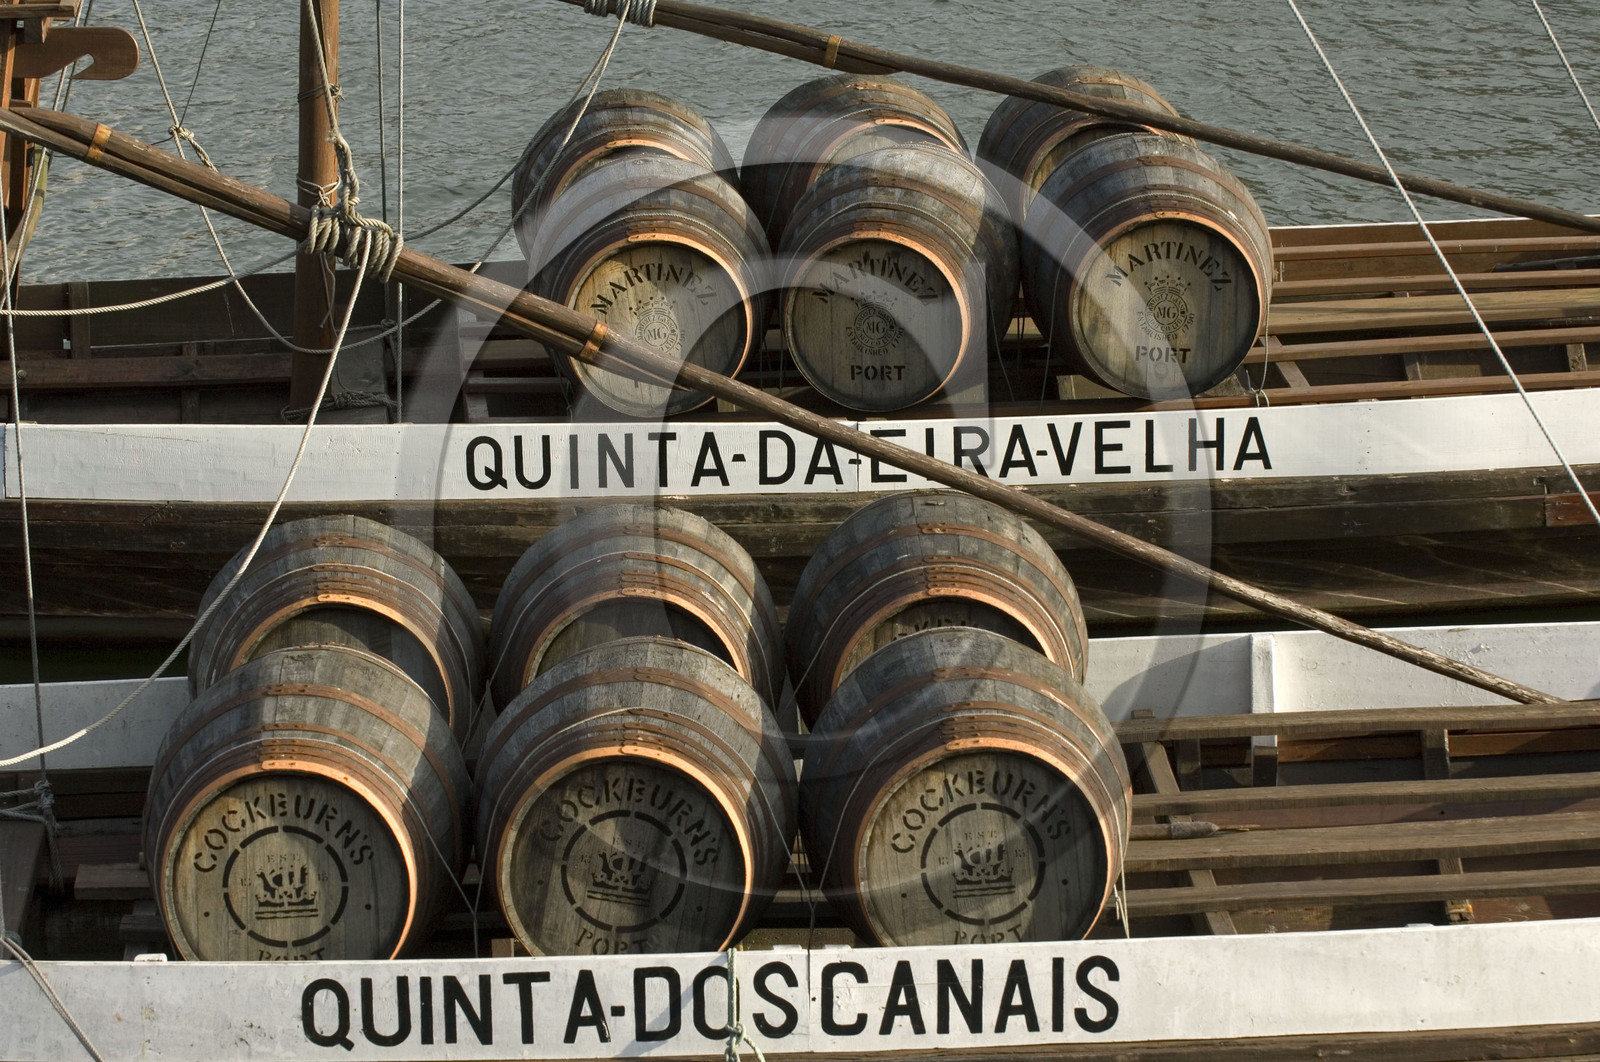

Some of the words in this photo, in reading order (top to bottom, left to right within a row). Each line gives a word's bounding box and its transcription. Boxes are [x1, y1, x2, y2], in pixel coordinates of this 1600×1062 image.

[811, 250, 939, 307] MARTINEZ
[1105, 241, 1233, 292] MARTINEZ
[591, 262, 718, 315] MARTINEZ
[865, 320, 886, 335] MG
[1156, 306, 1177, 319] MG
[1181, 312, 1196, 334] 1790
[647, 327, 667, 341] MG
[849, 364, 906, 381] PORT
[1134, 345, 1192, 364] PORT
[539, 777, 719, 867] COCKBURN'S
[890, 769, 1072, 854] COCKBURN'S
[193, 792, 374, 873] COCKBURN'S
